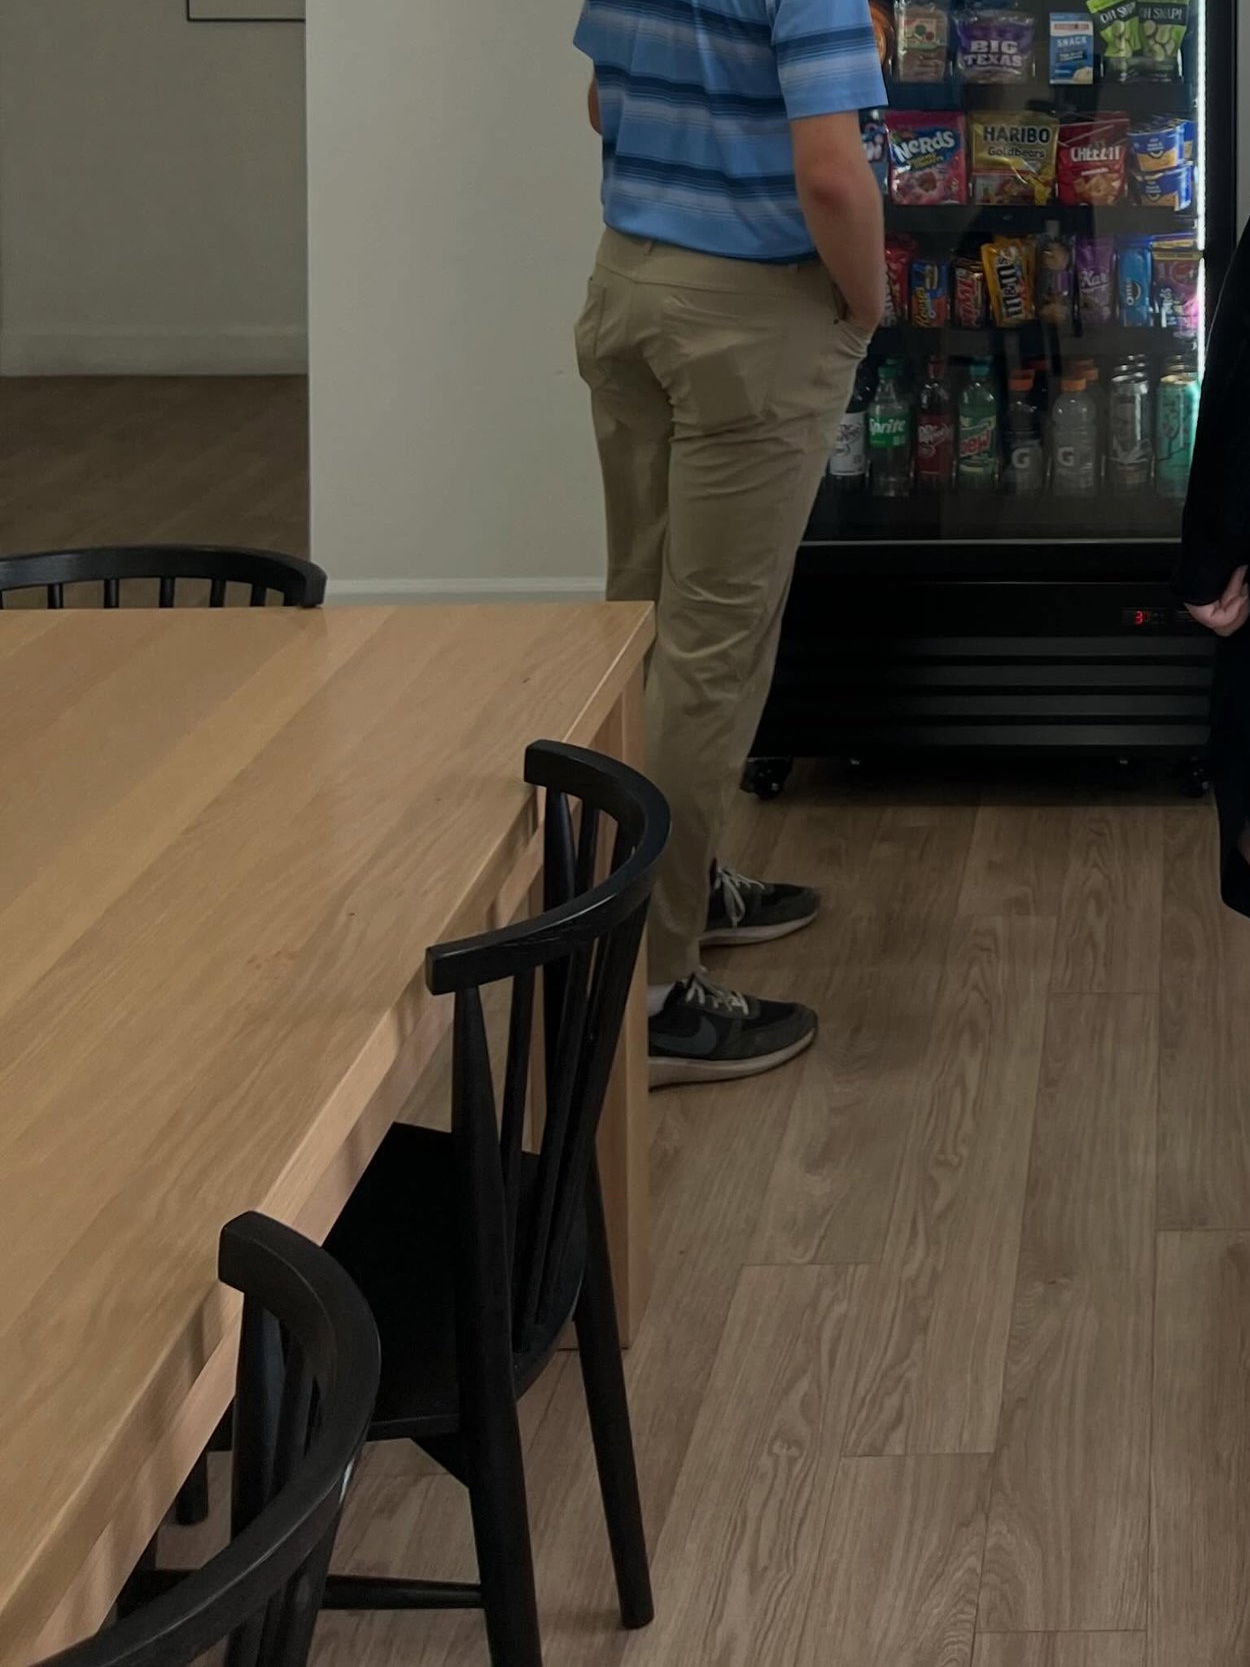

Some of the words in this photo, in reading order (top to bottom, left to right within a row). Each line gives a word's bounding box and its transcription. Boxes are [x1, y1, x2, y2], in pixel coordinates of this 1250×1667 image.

[969, 39, 1019, 54] BIG
[1056, 36, 1088, 48] SNACK
[963, 54, 1026, 68] TEXAS
[983, 125, 1051, 144] HARIBO
[987, 146, 1046, 159] Goldbears
[868, 417, 907, 437] Sprite
[1010, 447, 1031, 469] G
[1057, 446, 1074, 467] G
